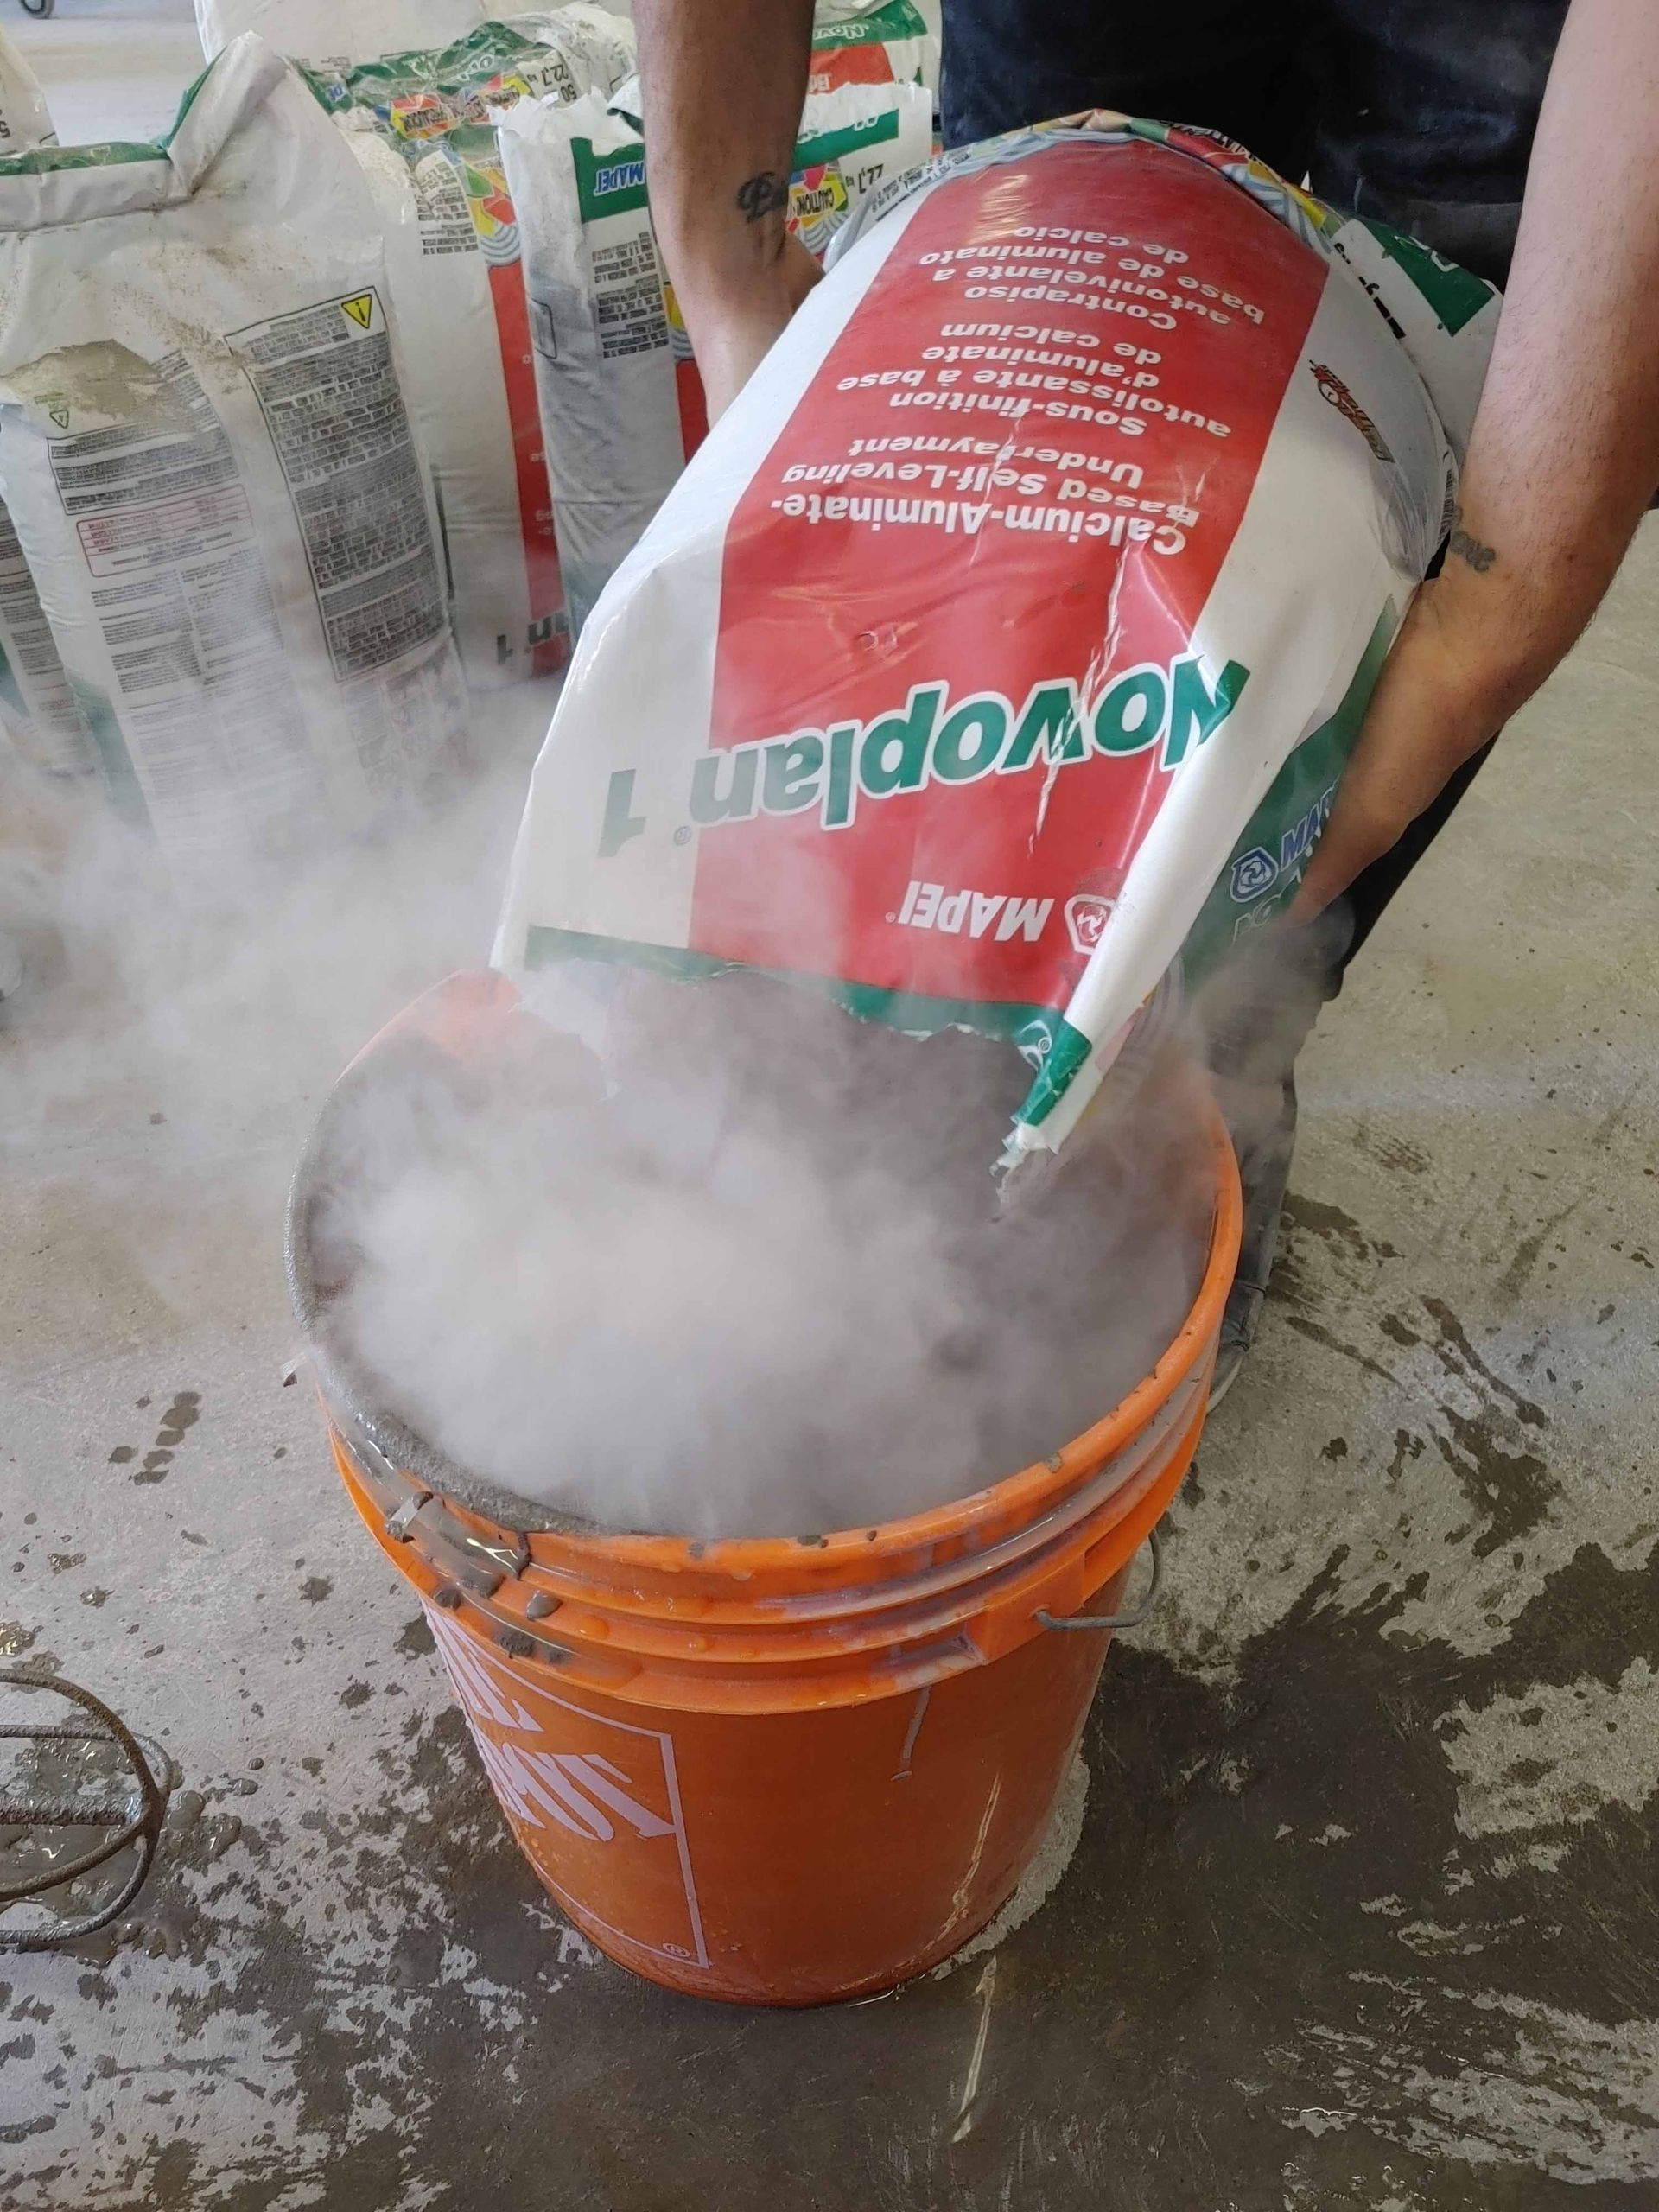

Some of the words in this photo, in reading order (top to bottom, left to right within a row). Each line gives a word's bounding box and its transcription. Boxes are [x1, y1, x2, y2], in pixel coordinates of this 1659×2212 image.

[560, 84, 577, 103] 50
[1014, 226, 1130, 251] calcio
[918, 245, 1105, 267] aluminato
[1118, 258, 1164, 281] de
[1141, 243, 1188, 266] de
[933, 267, 950, 283] a
[963, 284, 1177, 331] Contrapiso
[969, 264, 1231, 327] autonivelante
[1176, 274, 1264, 324] base
[940, 323, 1101, 350] calcium
[1114, 342, 1161, 366] de
[836, 367, 926, 393] base
[938, 369, 962, 388] à
[889, 391, 1147, 435] Sous-finition
[973, 368, 1230, 438] autolissante
[782, 461, 1048, 495] Self-Leveling
[1060, 477, 1199, 526] Based
[770, 493, 1186, 556] Calcium-Aluminate-
[598, 768, 647, 859] 1
[896, 880, 1055, 942] MAPEI
